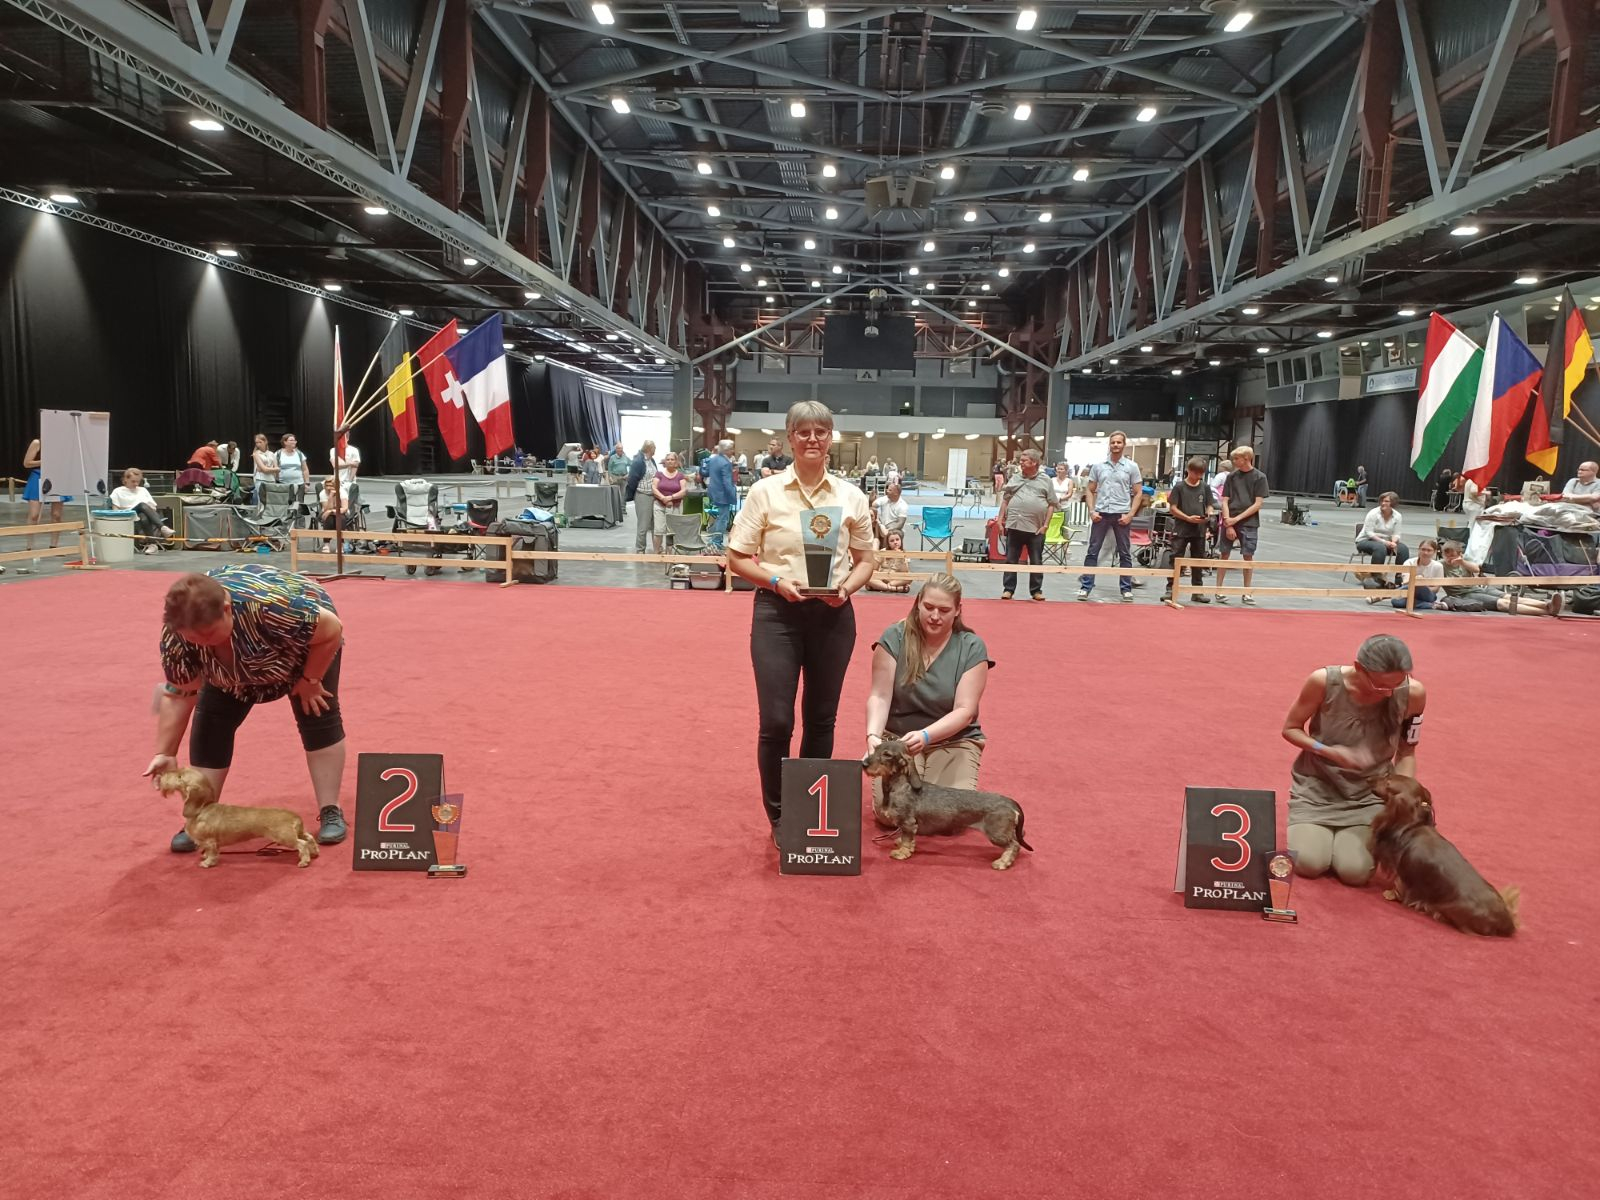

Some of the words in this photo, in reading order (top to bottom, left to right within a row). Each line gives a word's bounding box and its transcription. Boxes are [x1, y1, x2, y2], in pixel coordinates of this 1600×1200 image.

[379, 768, 418, 832] 2
[807, 774, 839, 837] 1
[1210, 803, 1251, 872] 3
